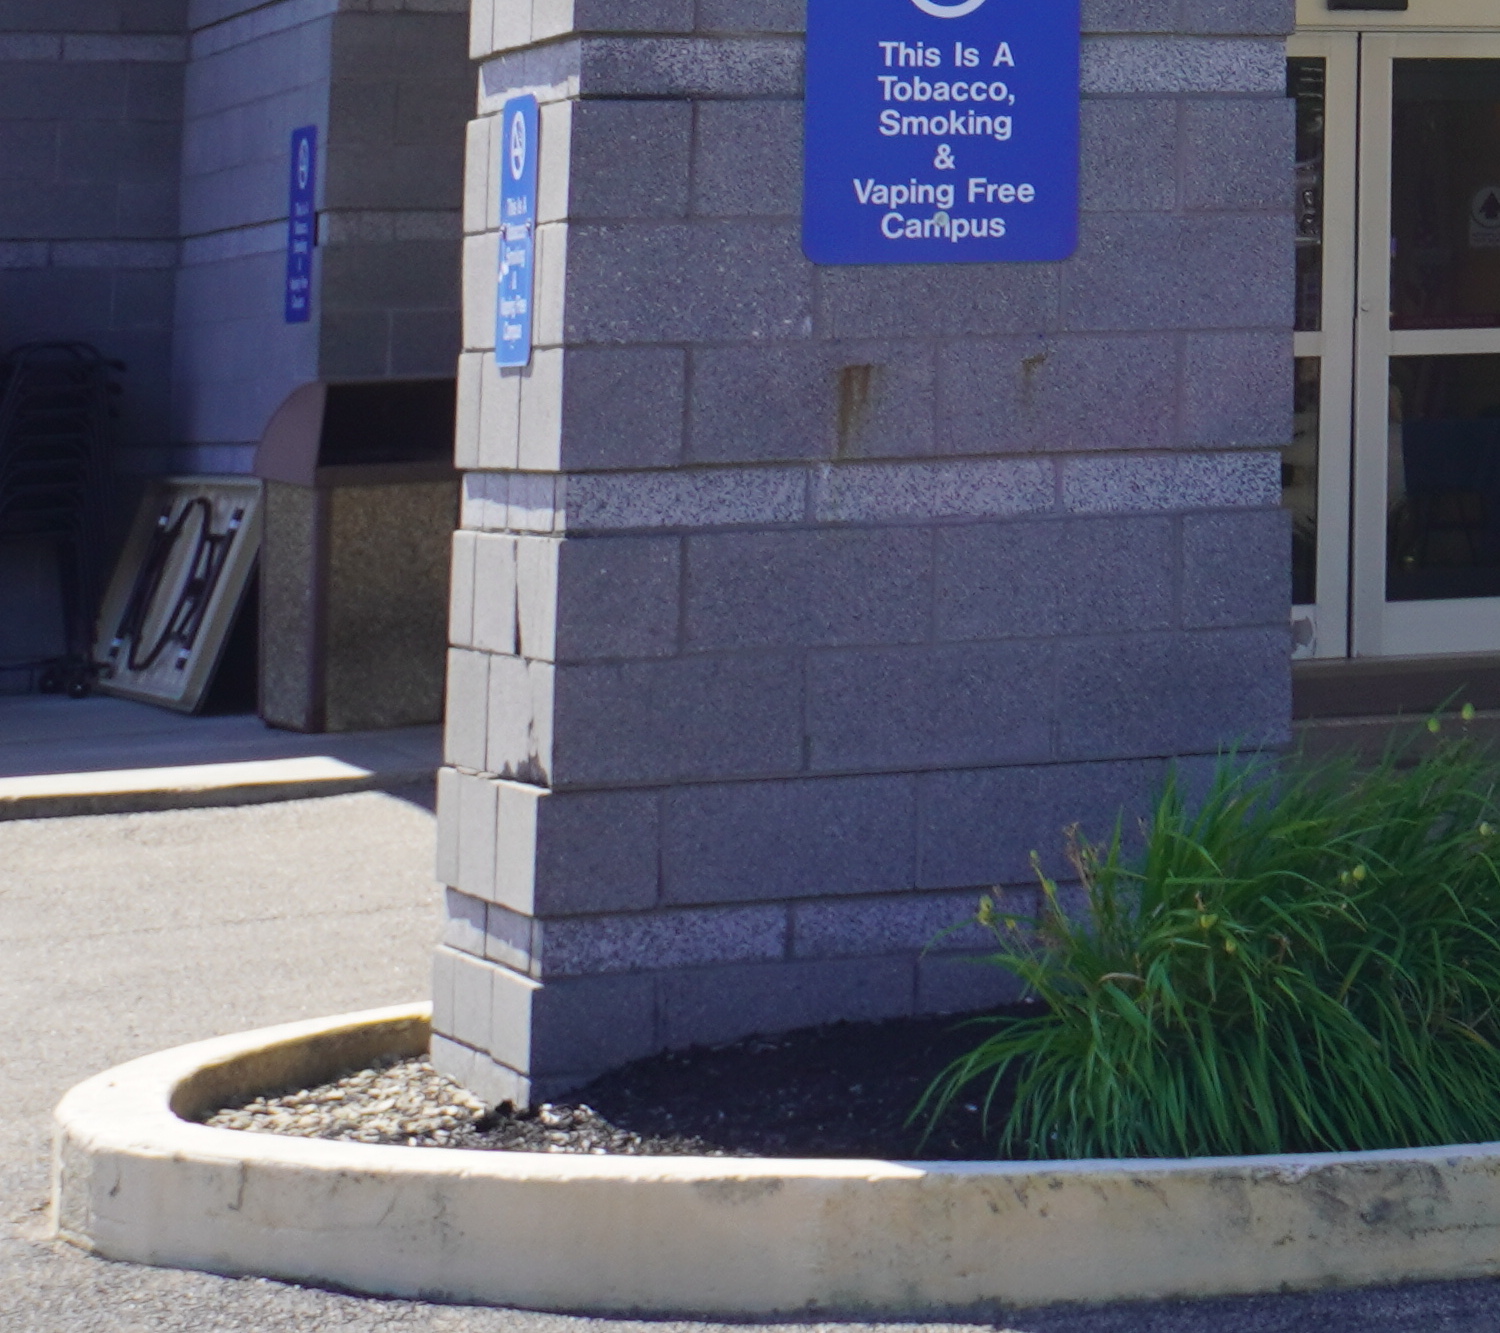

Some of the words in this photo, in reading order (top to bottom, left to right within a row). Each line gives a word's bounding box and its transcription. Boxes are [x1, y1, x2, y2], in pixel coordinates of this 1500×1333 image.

[878, 42, 941, 68] This
[955, 42, 980, 68] Is
[992, 42, 1015, 68] A
[878, 76, 1015, 105] Tobacco,
[878, 109, 1013, 141] Smoking
[933, 144, 955, 170] &
[853, 178, 955, 209] Vaping
[968, 178, 1035, 204] Free
[881, 213, 1006, 244] Campus
